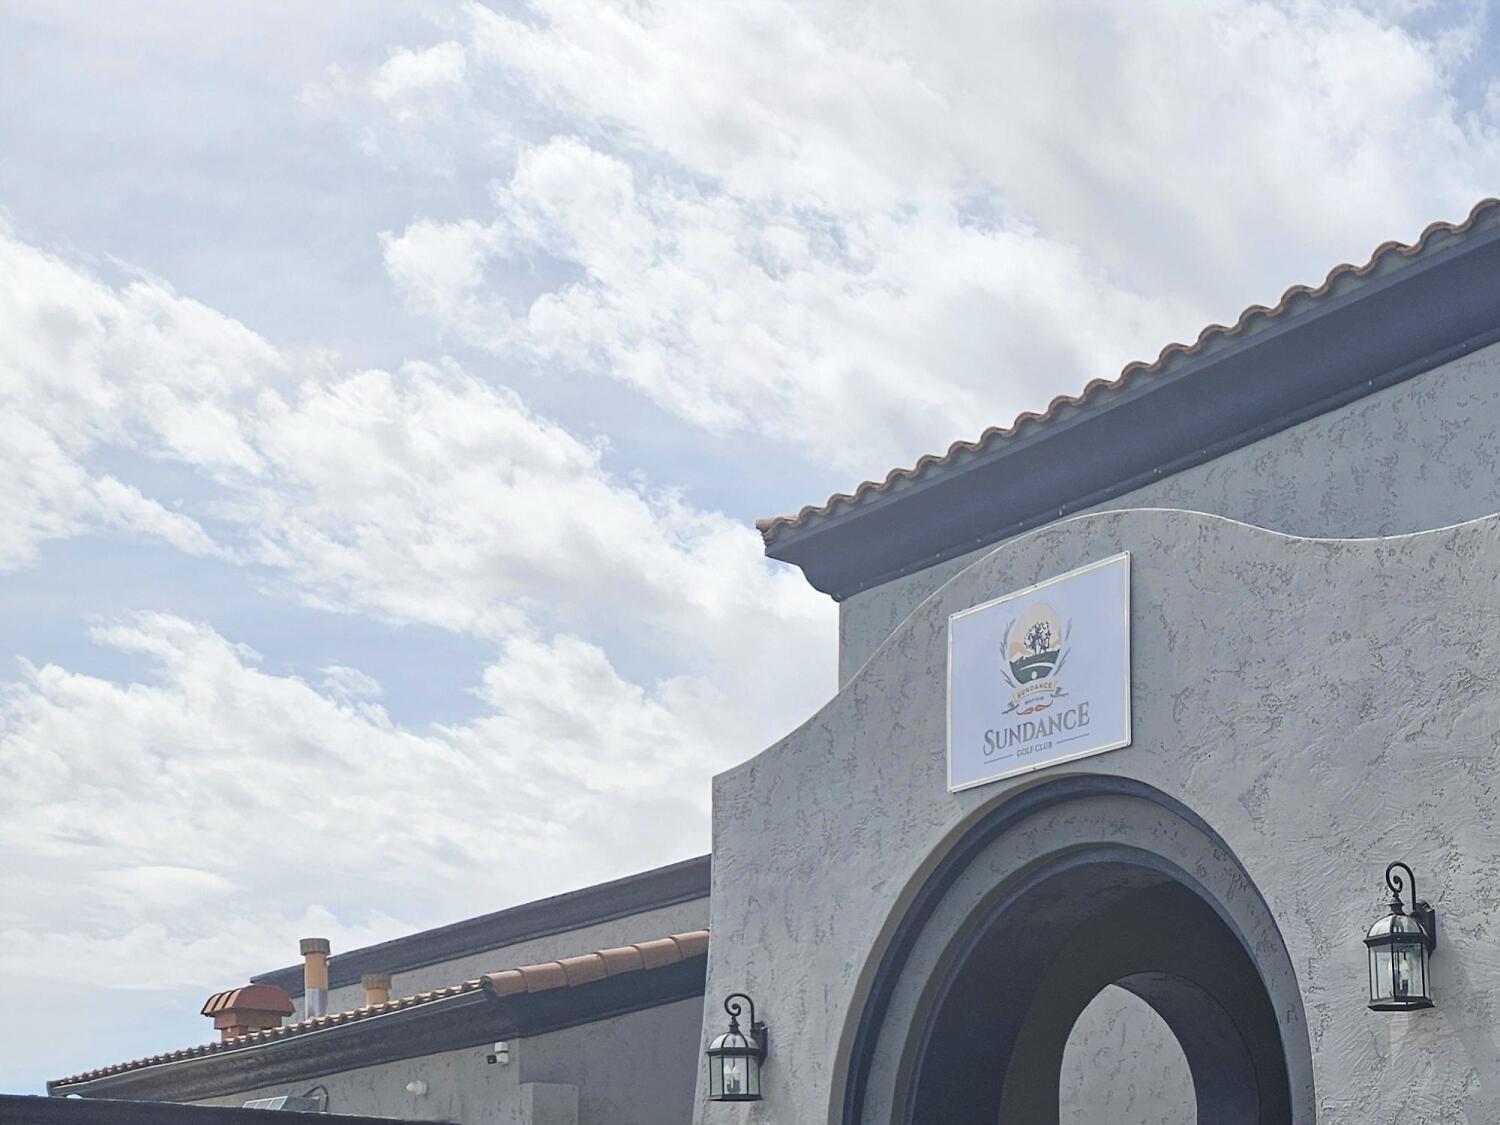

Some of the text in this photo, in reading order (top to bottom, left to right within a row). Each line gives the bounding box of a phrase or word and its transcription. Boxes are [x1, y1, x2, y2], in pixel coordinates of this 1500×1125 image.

[983, 701, 1090, 756] SUNDANCE
[1016, 741, 1053, 758] GOLF CLUB
